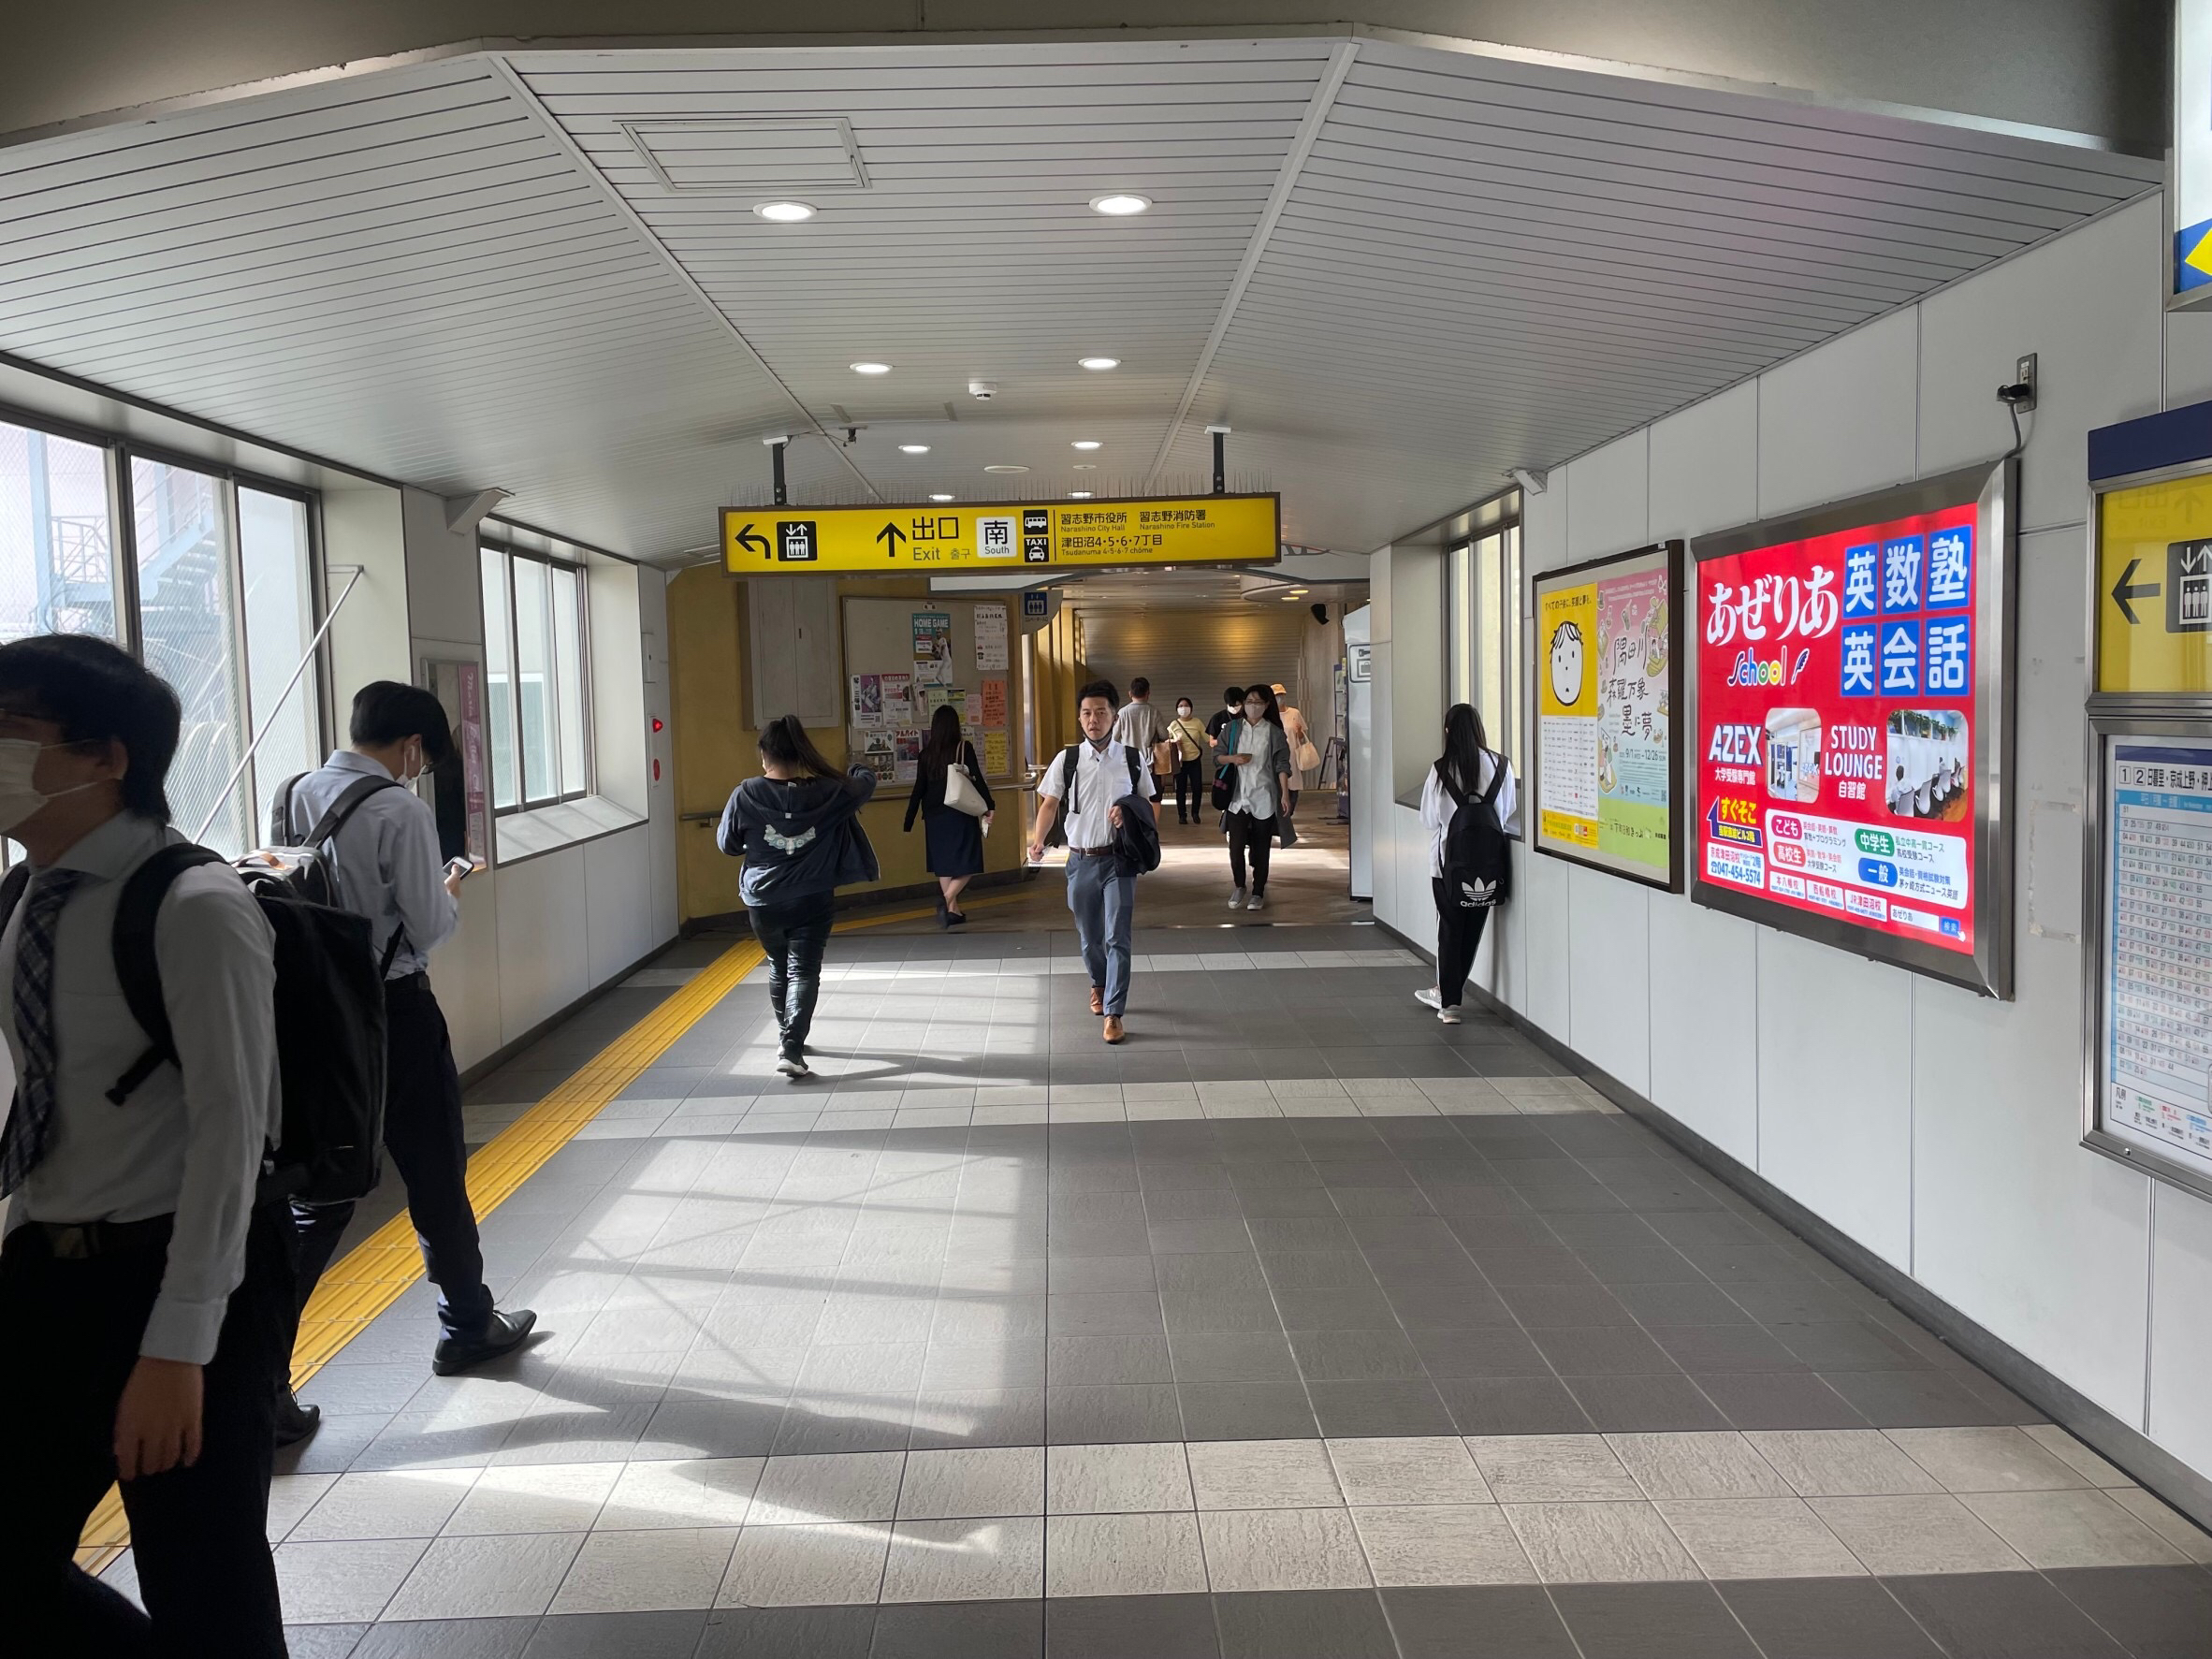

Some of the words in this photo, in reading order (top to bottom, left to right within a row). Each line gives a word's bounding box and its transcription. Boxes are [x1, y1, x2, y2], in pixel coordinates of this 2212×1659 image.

[1060, 513, 1128, 525] 習志野市役所
[1139, 509, 1206, 522] 習志野消防署
[1191, 521, 1215, 530] Station
[912, 517, 958, 541] 出口
[983, 520, 1008, 545] 南
[1098, 524, 1109, 533] City
[912, 547, 940, 560] Exit
[950, 548, 971, 560] 출구
[984, 546, 1010, 555] South
[1061, 548, 1101, 557] Tsudanuma
[1845, 534, 1968, 613] 英数塾
[1707, 565, 1839, 647] あぜりあ
[914, 618, 932, 628] HOME
[933, 618, 949, 628] GAME
[1843, 623, 1967, 691] 英会話
[1708, 723, 1763, 766] AZEX
[1830, 724, 1877, 751] STUDY
[1825, 751, 1883, 780] LOUNGE
[1714, 767, 1756, 786] 大学受験専門館
[1838, 781, 1866, 800] 自習館
[1721, 797, 1757, 824] すぐそこ
[1775, 819, 1798, 837] こども
[1858, 831, 1890, 854] 中学生
[1895, 836, 1944, 853] 私立中高一貫コース
[1777, 844, 1803, 865] 高校生
[1896, 848, 1934, 863] 高校受験コース
[1717, 862, 1761, 885] 047-454-5574
[1867, 864, 1888, 883] 一般
[1460, 899, 1497, 908] adidas
[1892, 908, 1914, 922] あぜりあ
